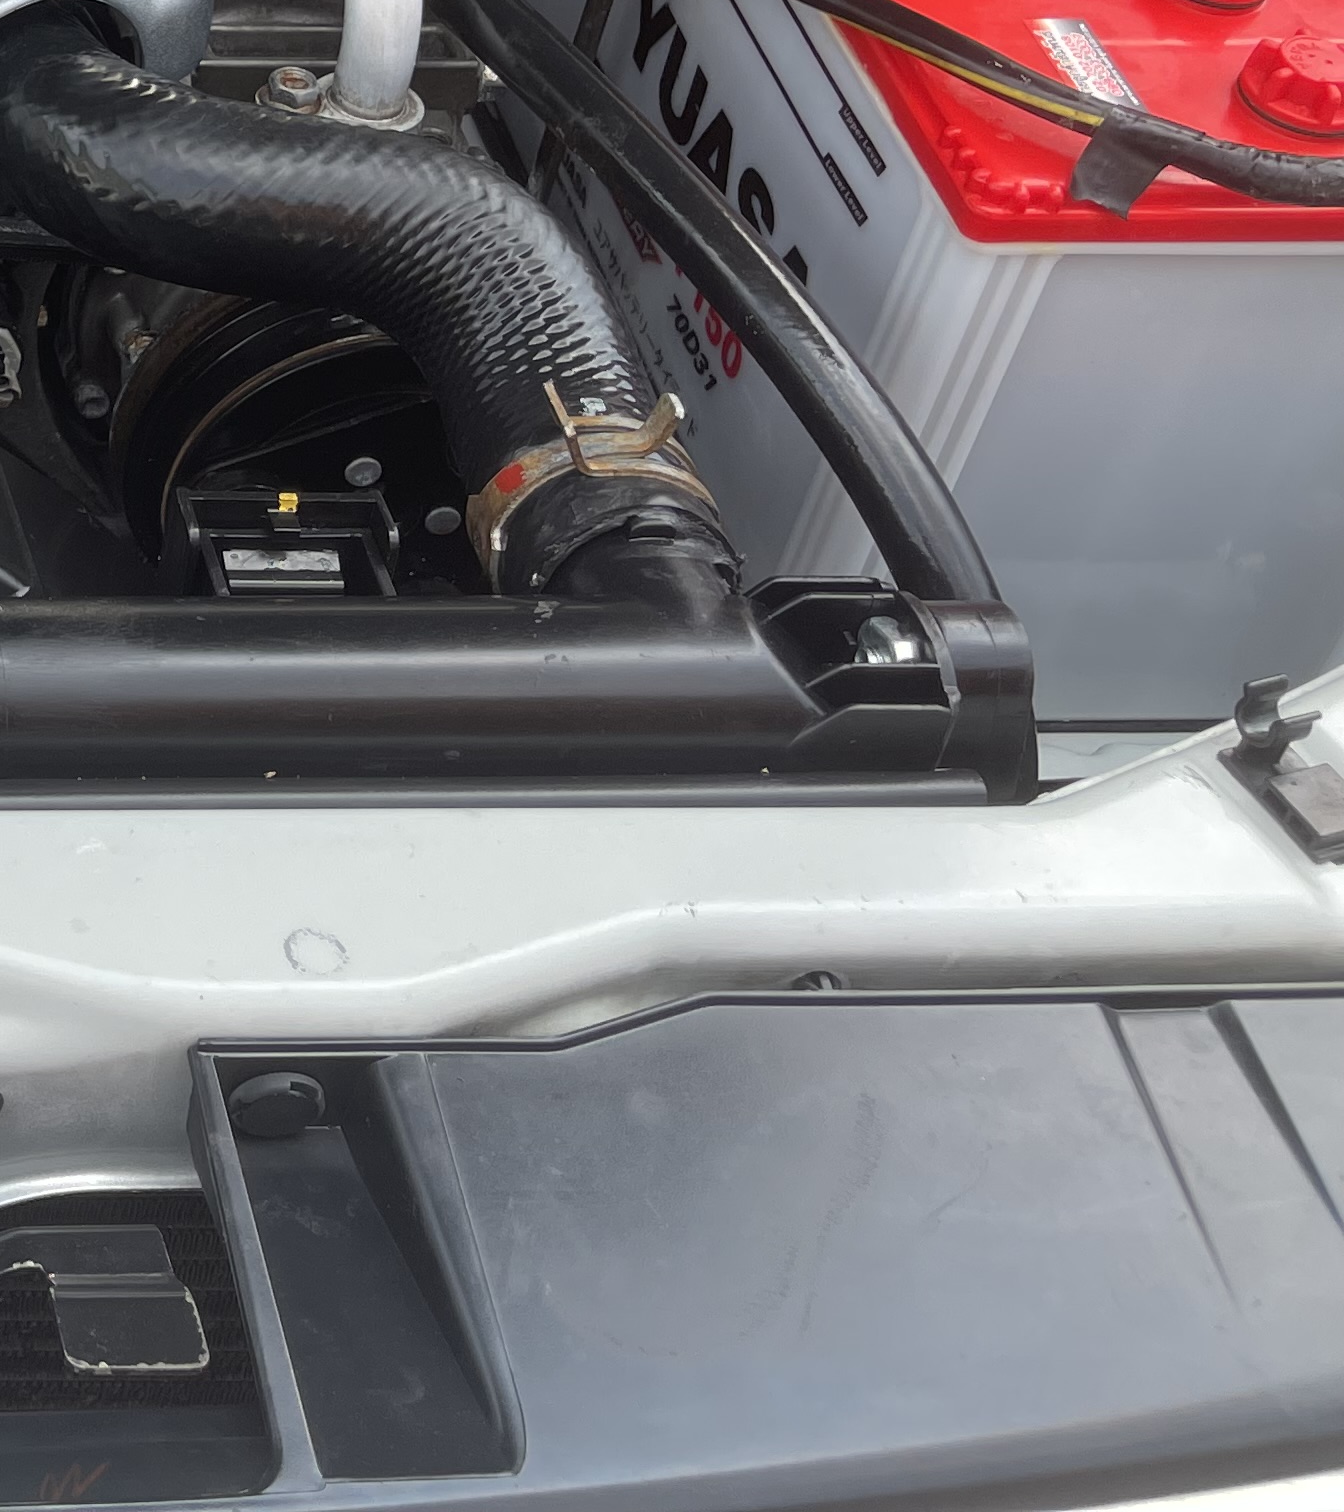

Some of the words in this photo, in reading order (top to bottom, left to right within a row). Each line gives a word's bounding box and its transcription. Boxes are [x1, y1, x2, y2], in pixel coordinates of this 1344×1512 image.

[843, 107, 864, 141] Upper
[861, 138, 884, 171] Level
[824, 158, 847, 193] Lower
[844, 190, 866, 223] Level
[666, 293, 718, 392] 70D31
